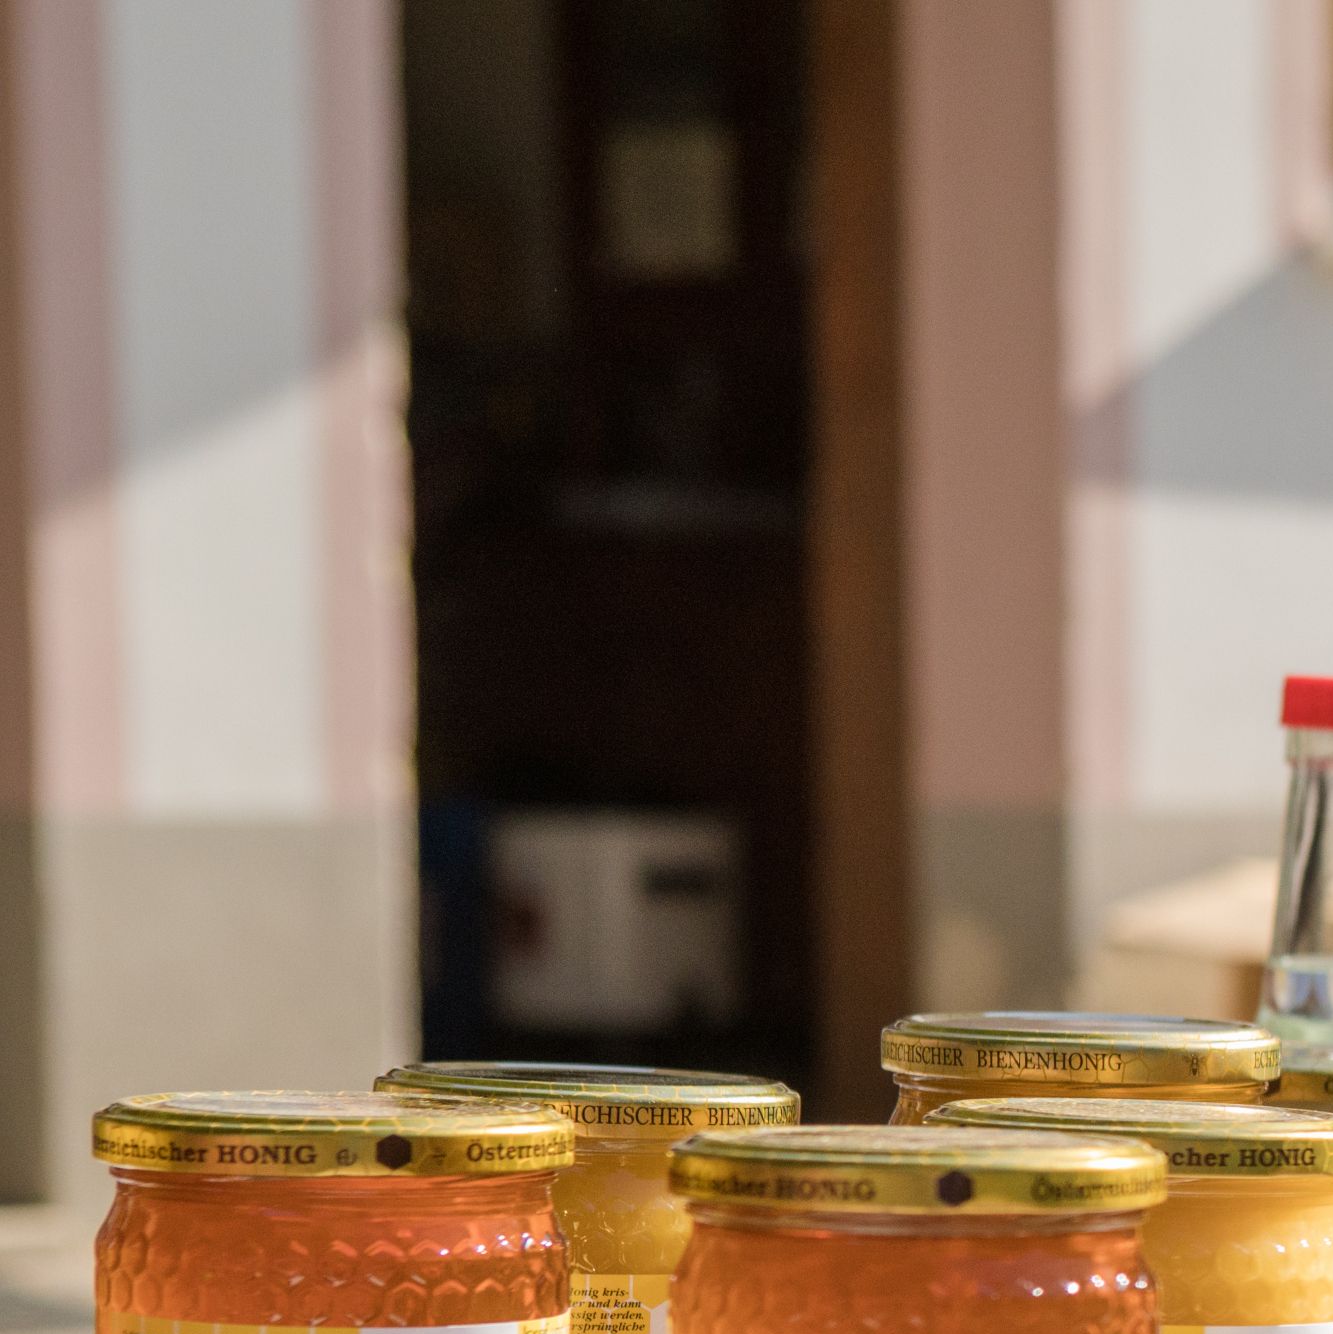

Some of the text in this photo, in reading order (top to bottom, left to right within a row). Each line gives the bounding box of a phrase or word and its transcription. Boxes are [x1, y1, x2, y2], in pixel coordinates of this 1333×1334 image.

[976, 1051, 1123, 1071] BIENENHONIG
[217, 1144, 318, 1165] HONIG
[1238, 1147, 1317, 1168] HONIG
[775, 1173, 877, 1201] HONIG
[588, 1299, 642, 1309] und kann
[600, 1311, 644, 1320] werden.
